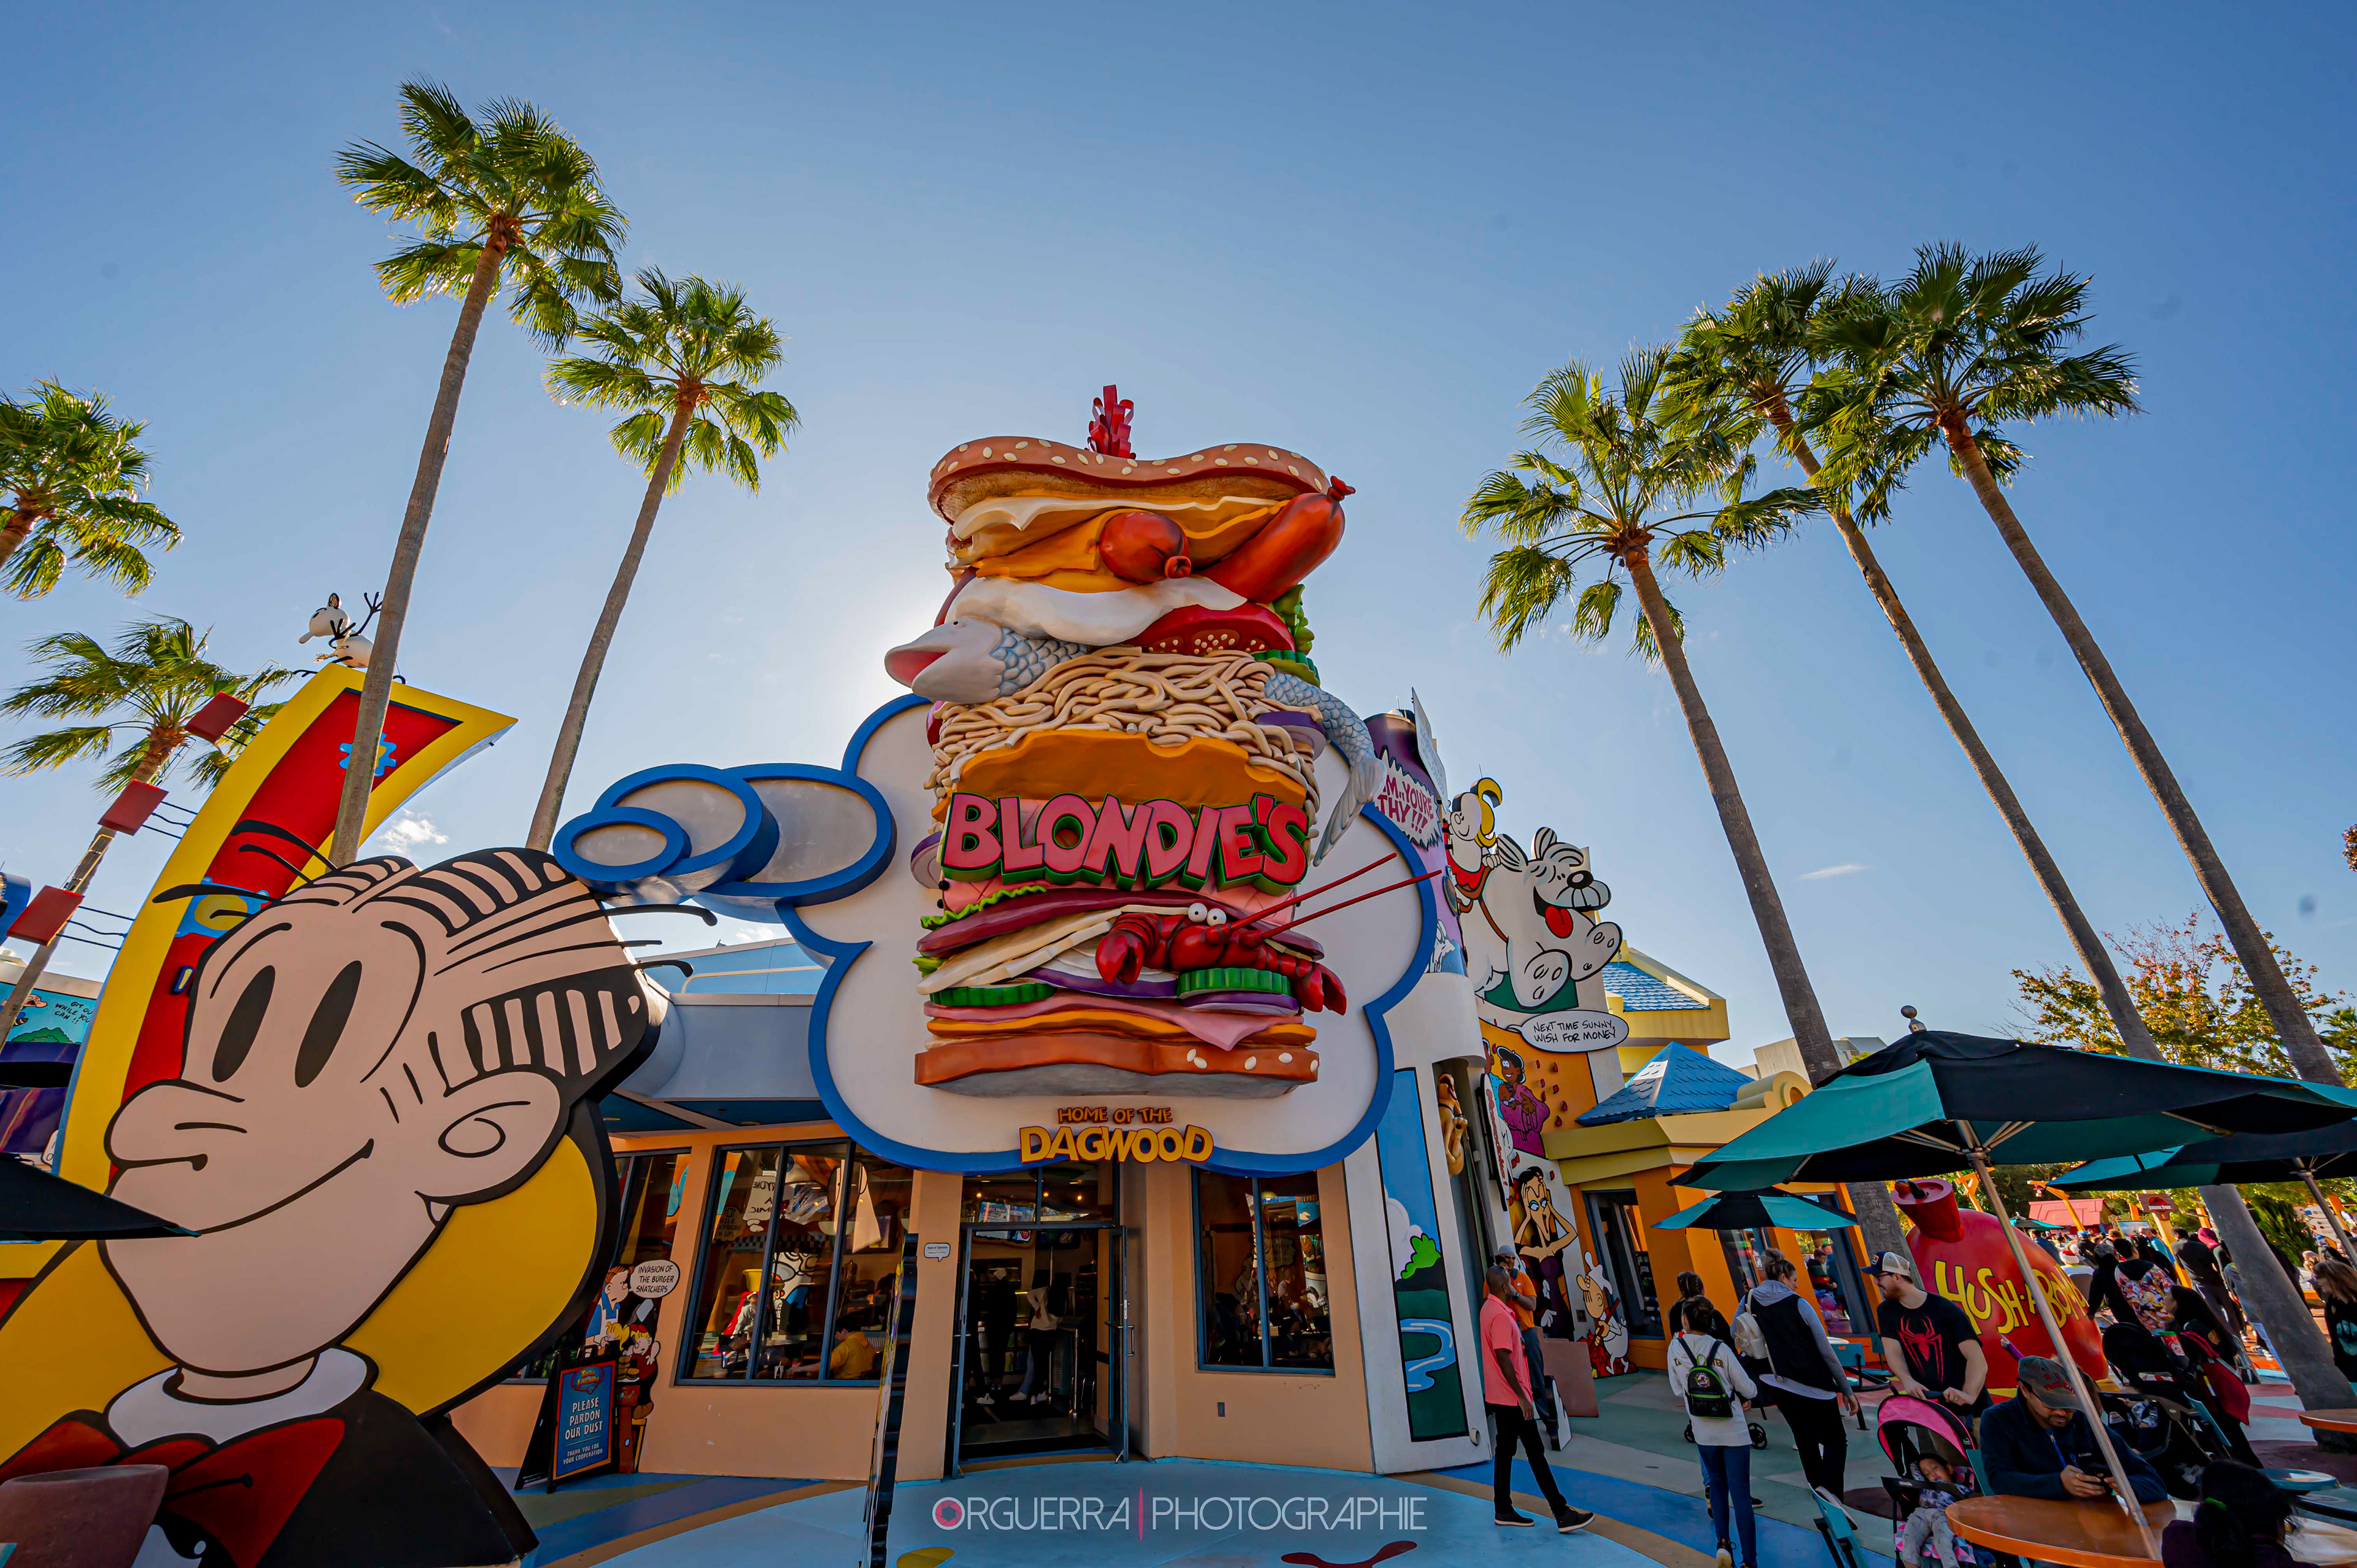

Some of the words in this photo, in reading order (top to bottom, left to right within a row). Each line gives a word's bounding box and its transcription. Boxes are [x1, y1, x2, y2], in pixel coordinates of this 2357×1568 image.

[941, 793, 1310, 895] BLONDIE'S
[55, 1003, 78, 1015] WHILE
[79, 1014, 90, 1022] YOU
[55, 1011, 70, 1020] CAN
[1534, 1021, 1556, 1032] NEXT
[1557, 1021, 1579, 1030] TIME
[1582, 1020, 1615, 1030] SUNNY,
[1534, 1033, 1558, 1043] WISH
[1563, 1033, 1580, 1043] FOR
[1584, 1029, 1616, 1040] MONEY
[1058, 1106, 1108, 1124] HOME
[1113, 1108, 1134, 1124] OF
[1138, 1107, 1172, 1124] THE
[1020, 1124, 1214, 1164] DAGWOOD
[638, 1265, 665, 1274] INVASION
[572, 1397, 599, 1413] PLEASE
[570, 1409, 600, 1426] PARDON
[565, 1427, 581, 1440] OUR
[584, 1421, 603, 1435] DUST
[575, 1449, 603, 1461] COOPERATION
